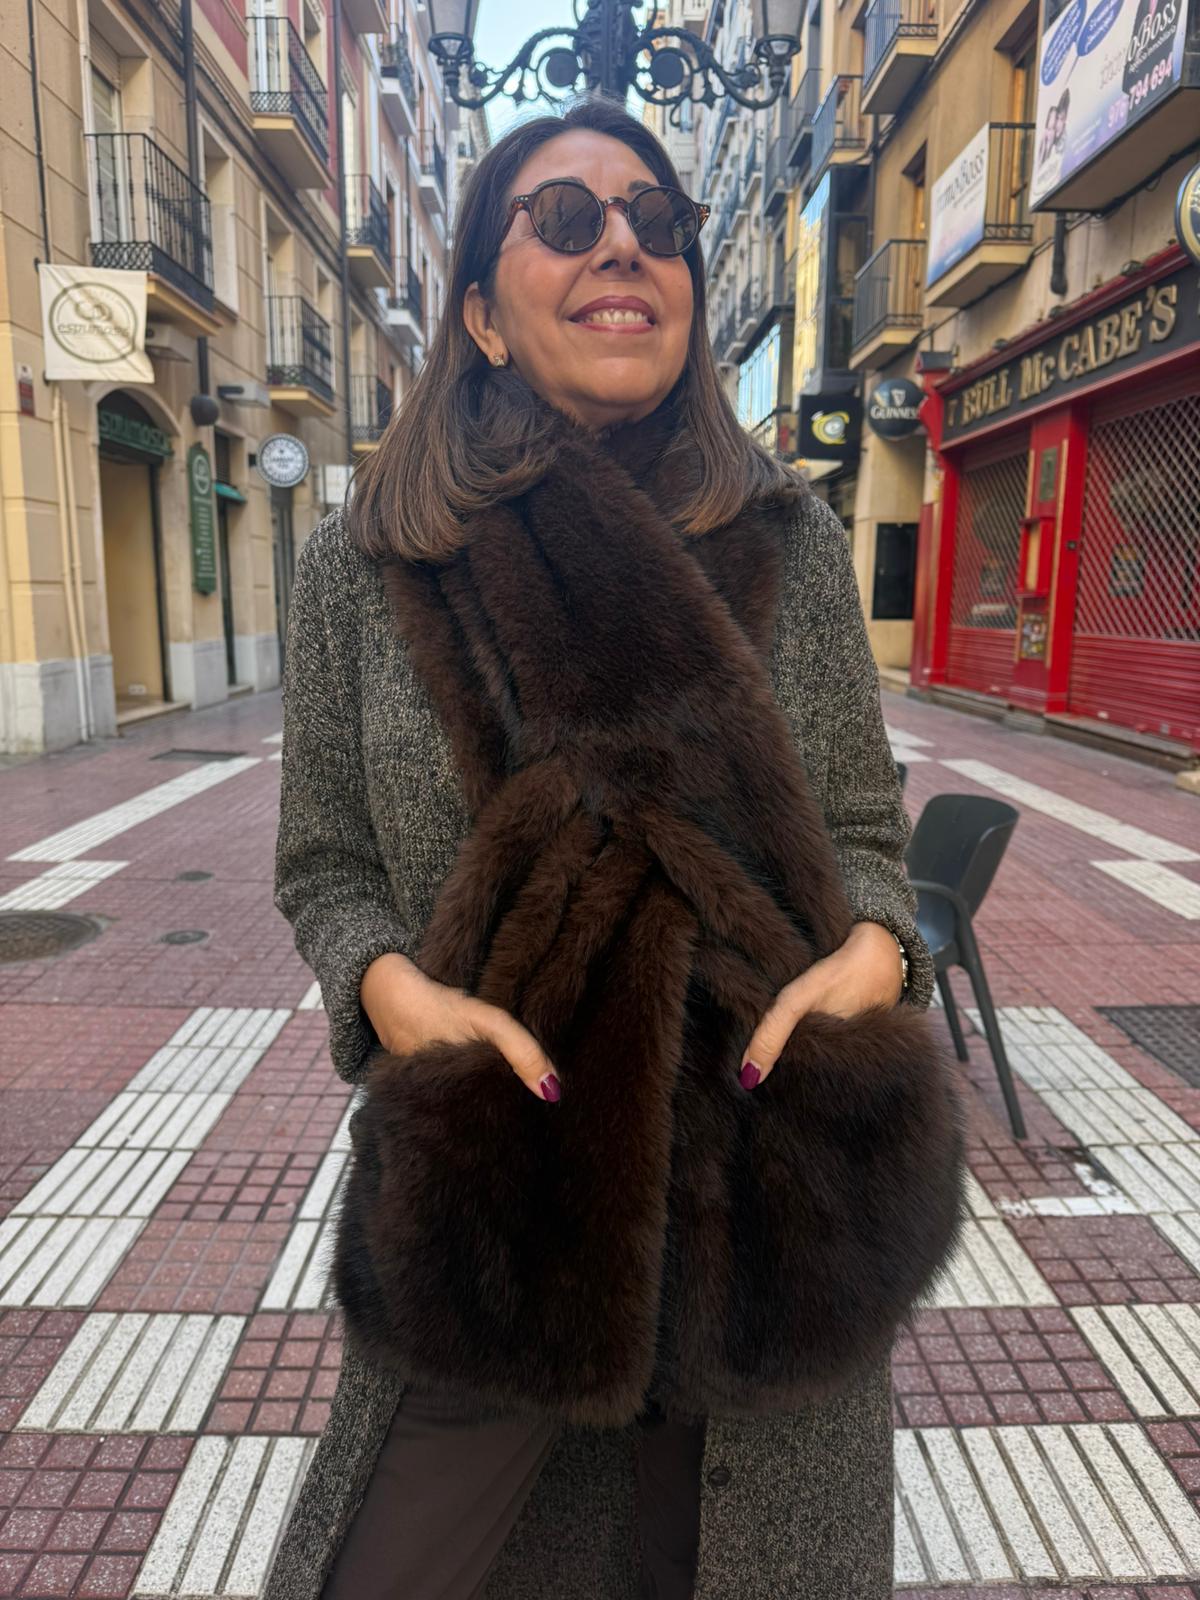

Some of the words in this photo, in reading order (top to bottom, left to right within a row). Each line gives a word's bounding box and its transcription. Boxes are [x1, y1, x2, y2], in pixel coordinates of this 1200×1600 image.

[1129, 73, 1150, 111] 794
[1151, 51, 1174, 91] 694
[962, 368, 1013, 427] BULL
